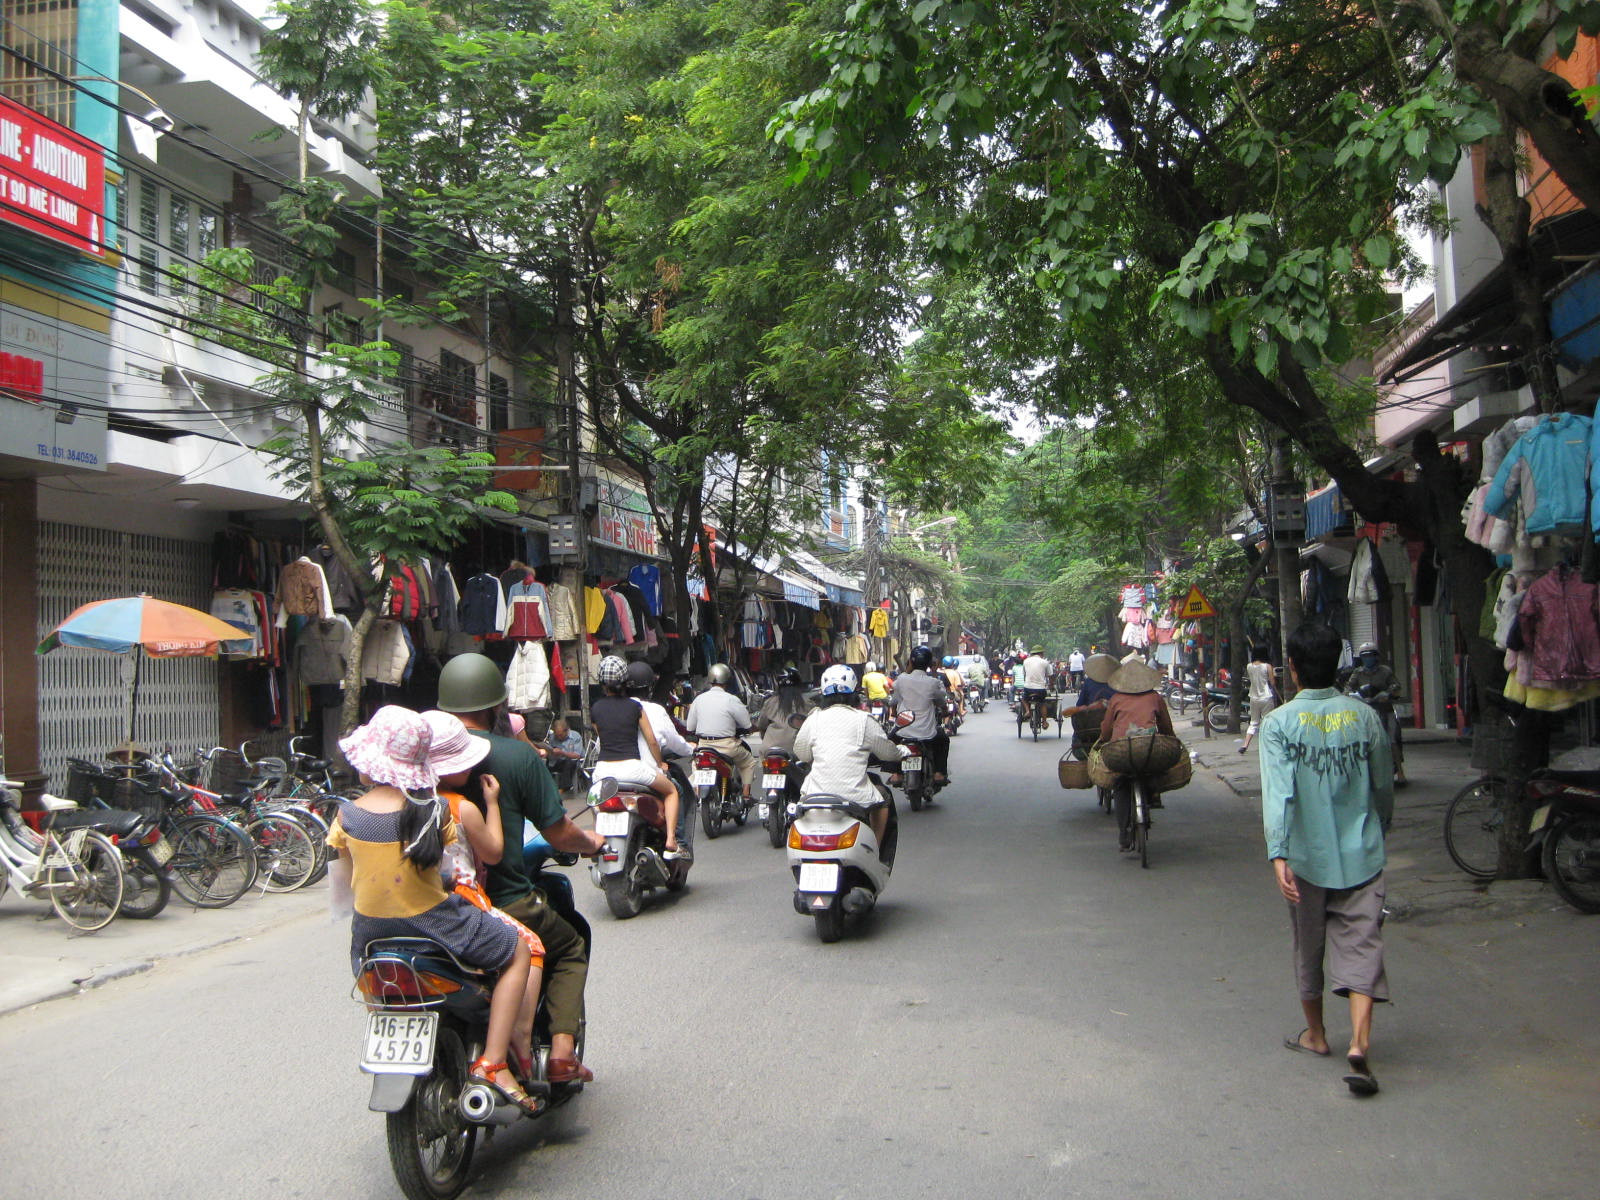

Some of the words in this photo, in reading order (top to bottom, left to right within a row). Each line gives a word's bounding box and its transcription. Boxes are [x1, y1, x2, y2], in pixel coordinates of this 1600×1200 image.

[33, 134, 87, 190] AUDITION
[50, 196, 78, 225] LINH
[380, 1017, 428, 1038] 16-F7
[373, 1040, 423, 1061] 4579
